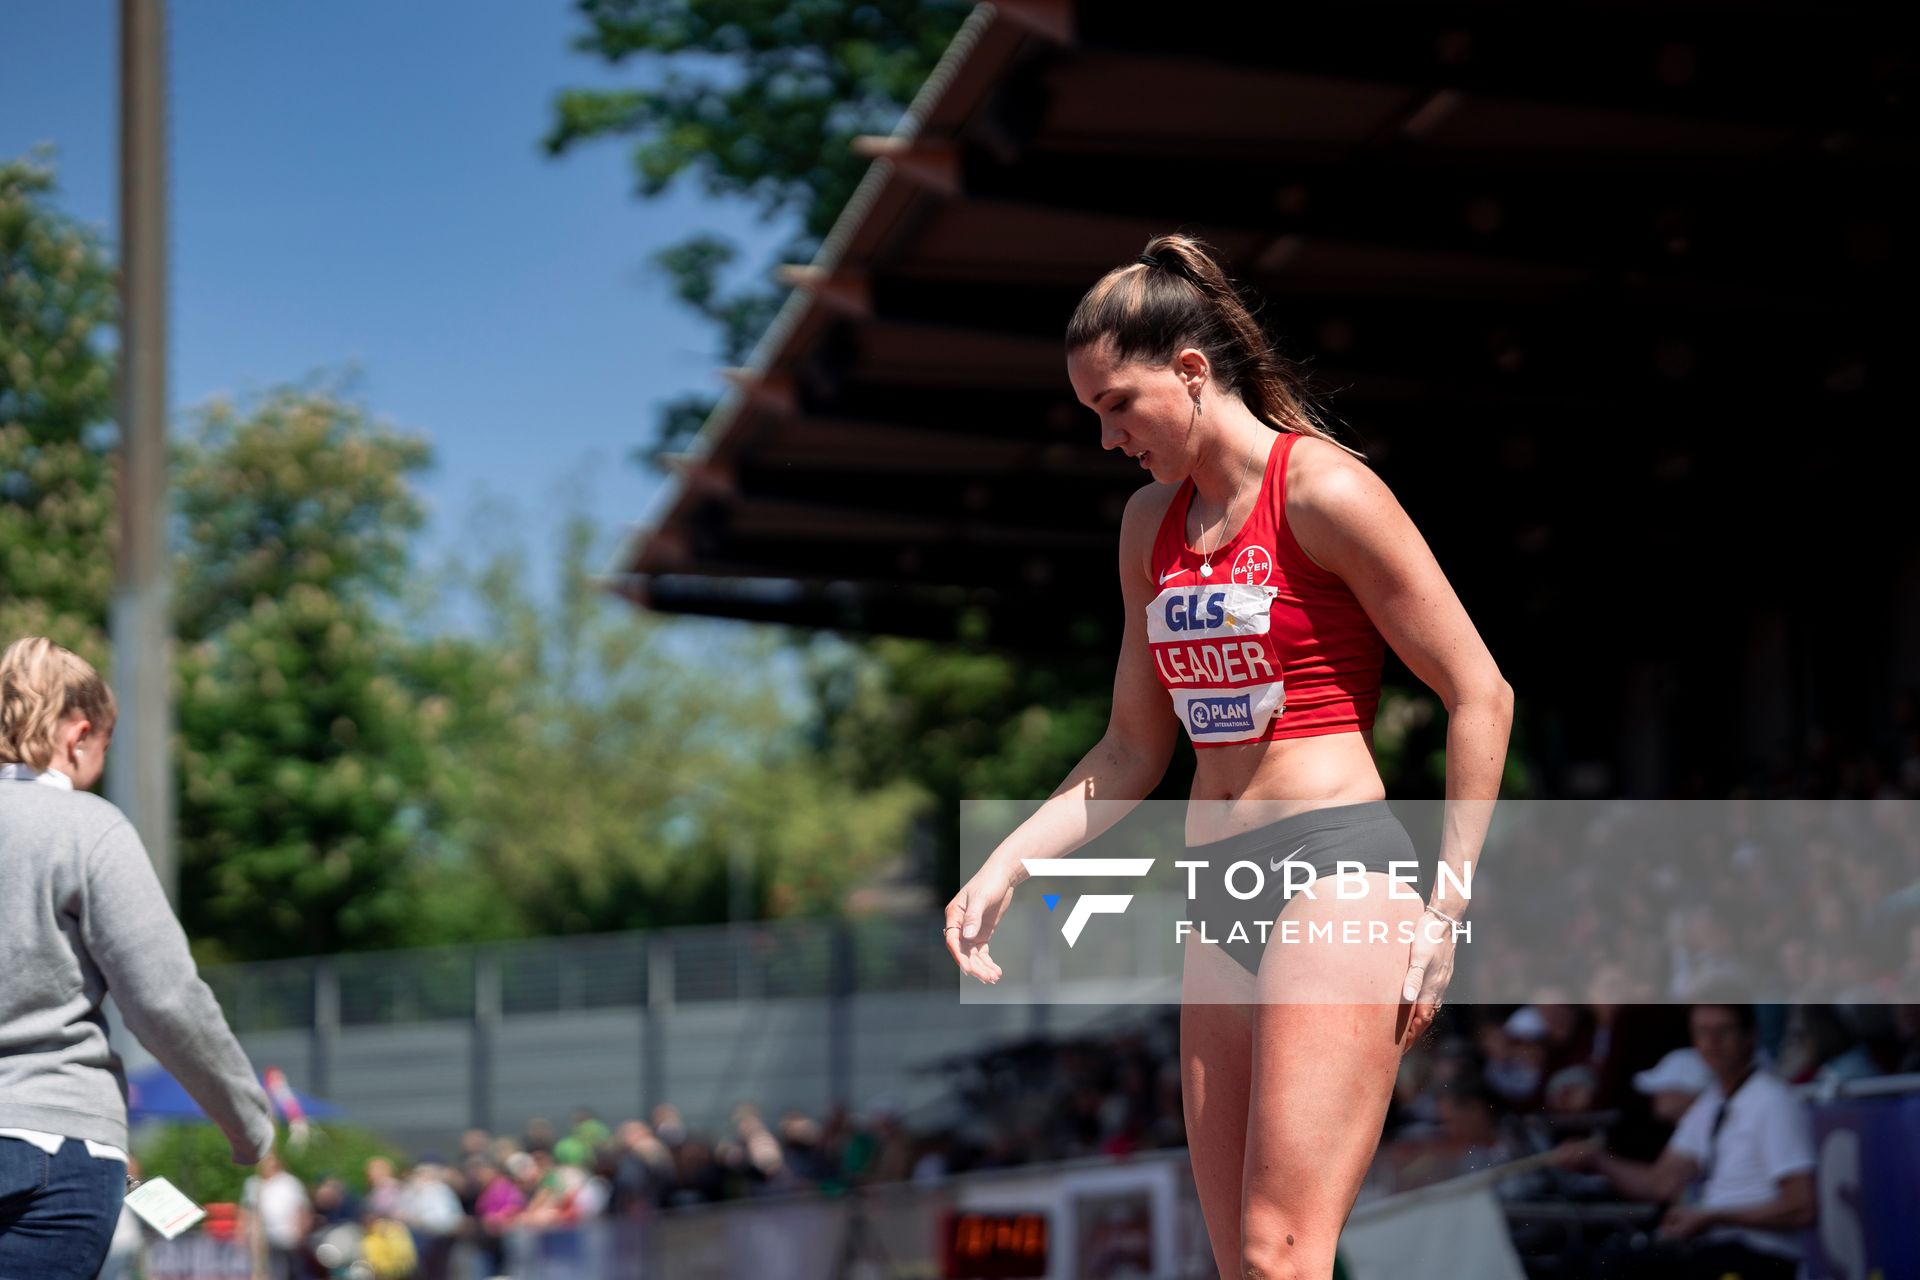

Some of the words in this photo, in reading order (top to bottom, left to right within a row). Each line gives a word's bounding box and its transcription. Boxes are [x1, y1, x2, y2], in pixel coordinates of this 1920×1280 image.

[1234, 563, 1268, 575] BAYER
[1165, 592, 1226, 632] GLS
[1156, 641, 1274, 684] LEADER
[1211, 702, 1248, 720] PLAN
